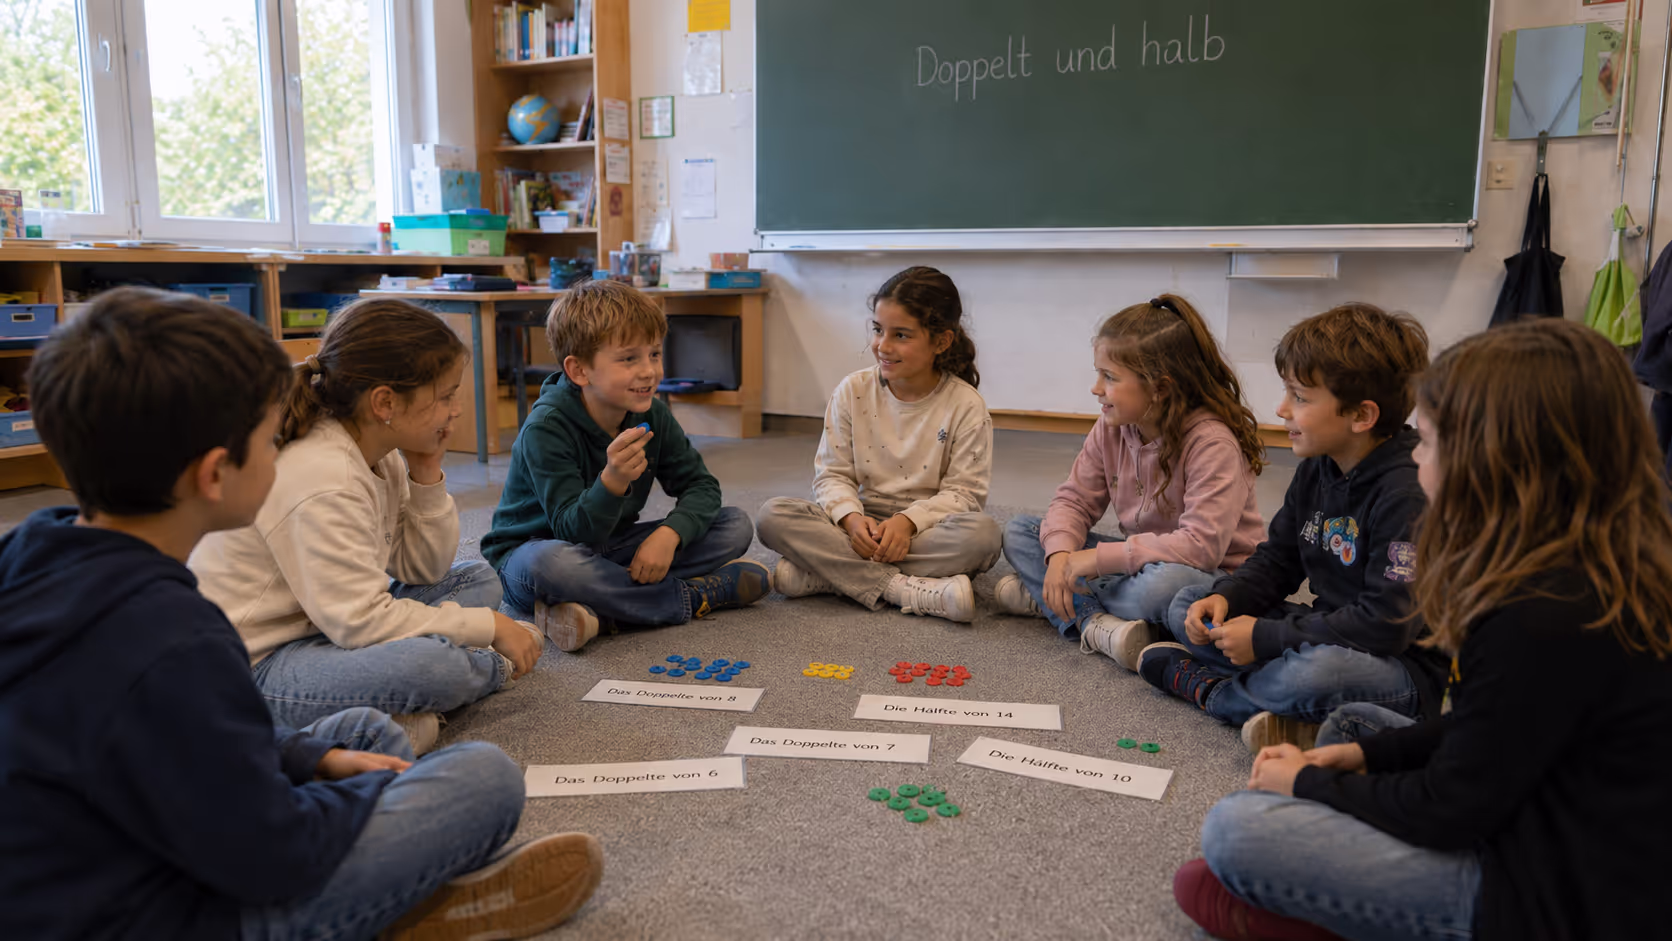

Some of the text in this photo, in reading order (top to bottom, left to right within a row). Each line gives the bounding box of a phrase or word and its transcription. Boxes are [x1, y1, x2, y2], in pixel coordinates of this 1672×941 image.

[916, 14, 1226, 102] Doppelt und halb
[607, 687, 632, 696] Das
[636, 689, 694, 699] Doppelte
[883, 704, 908, 712] Die
[749, 737, 777, 745] Das
[782, 738, 847, 749] Doppelte
[886, 743, 896, 751] 7
[988, 749, 1015, 760] Die
[1075, 768, 1104, 778] von
[1112, 773, 1132, 783] 10
[554, 769, 718, 784] Das Doppelte von 6
